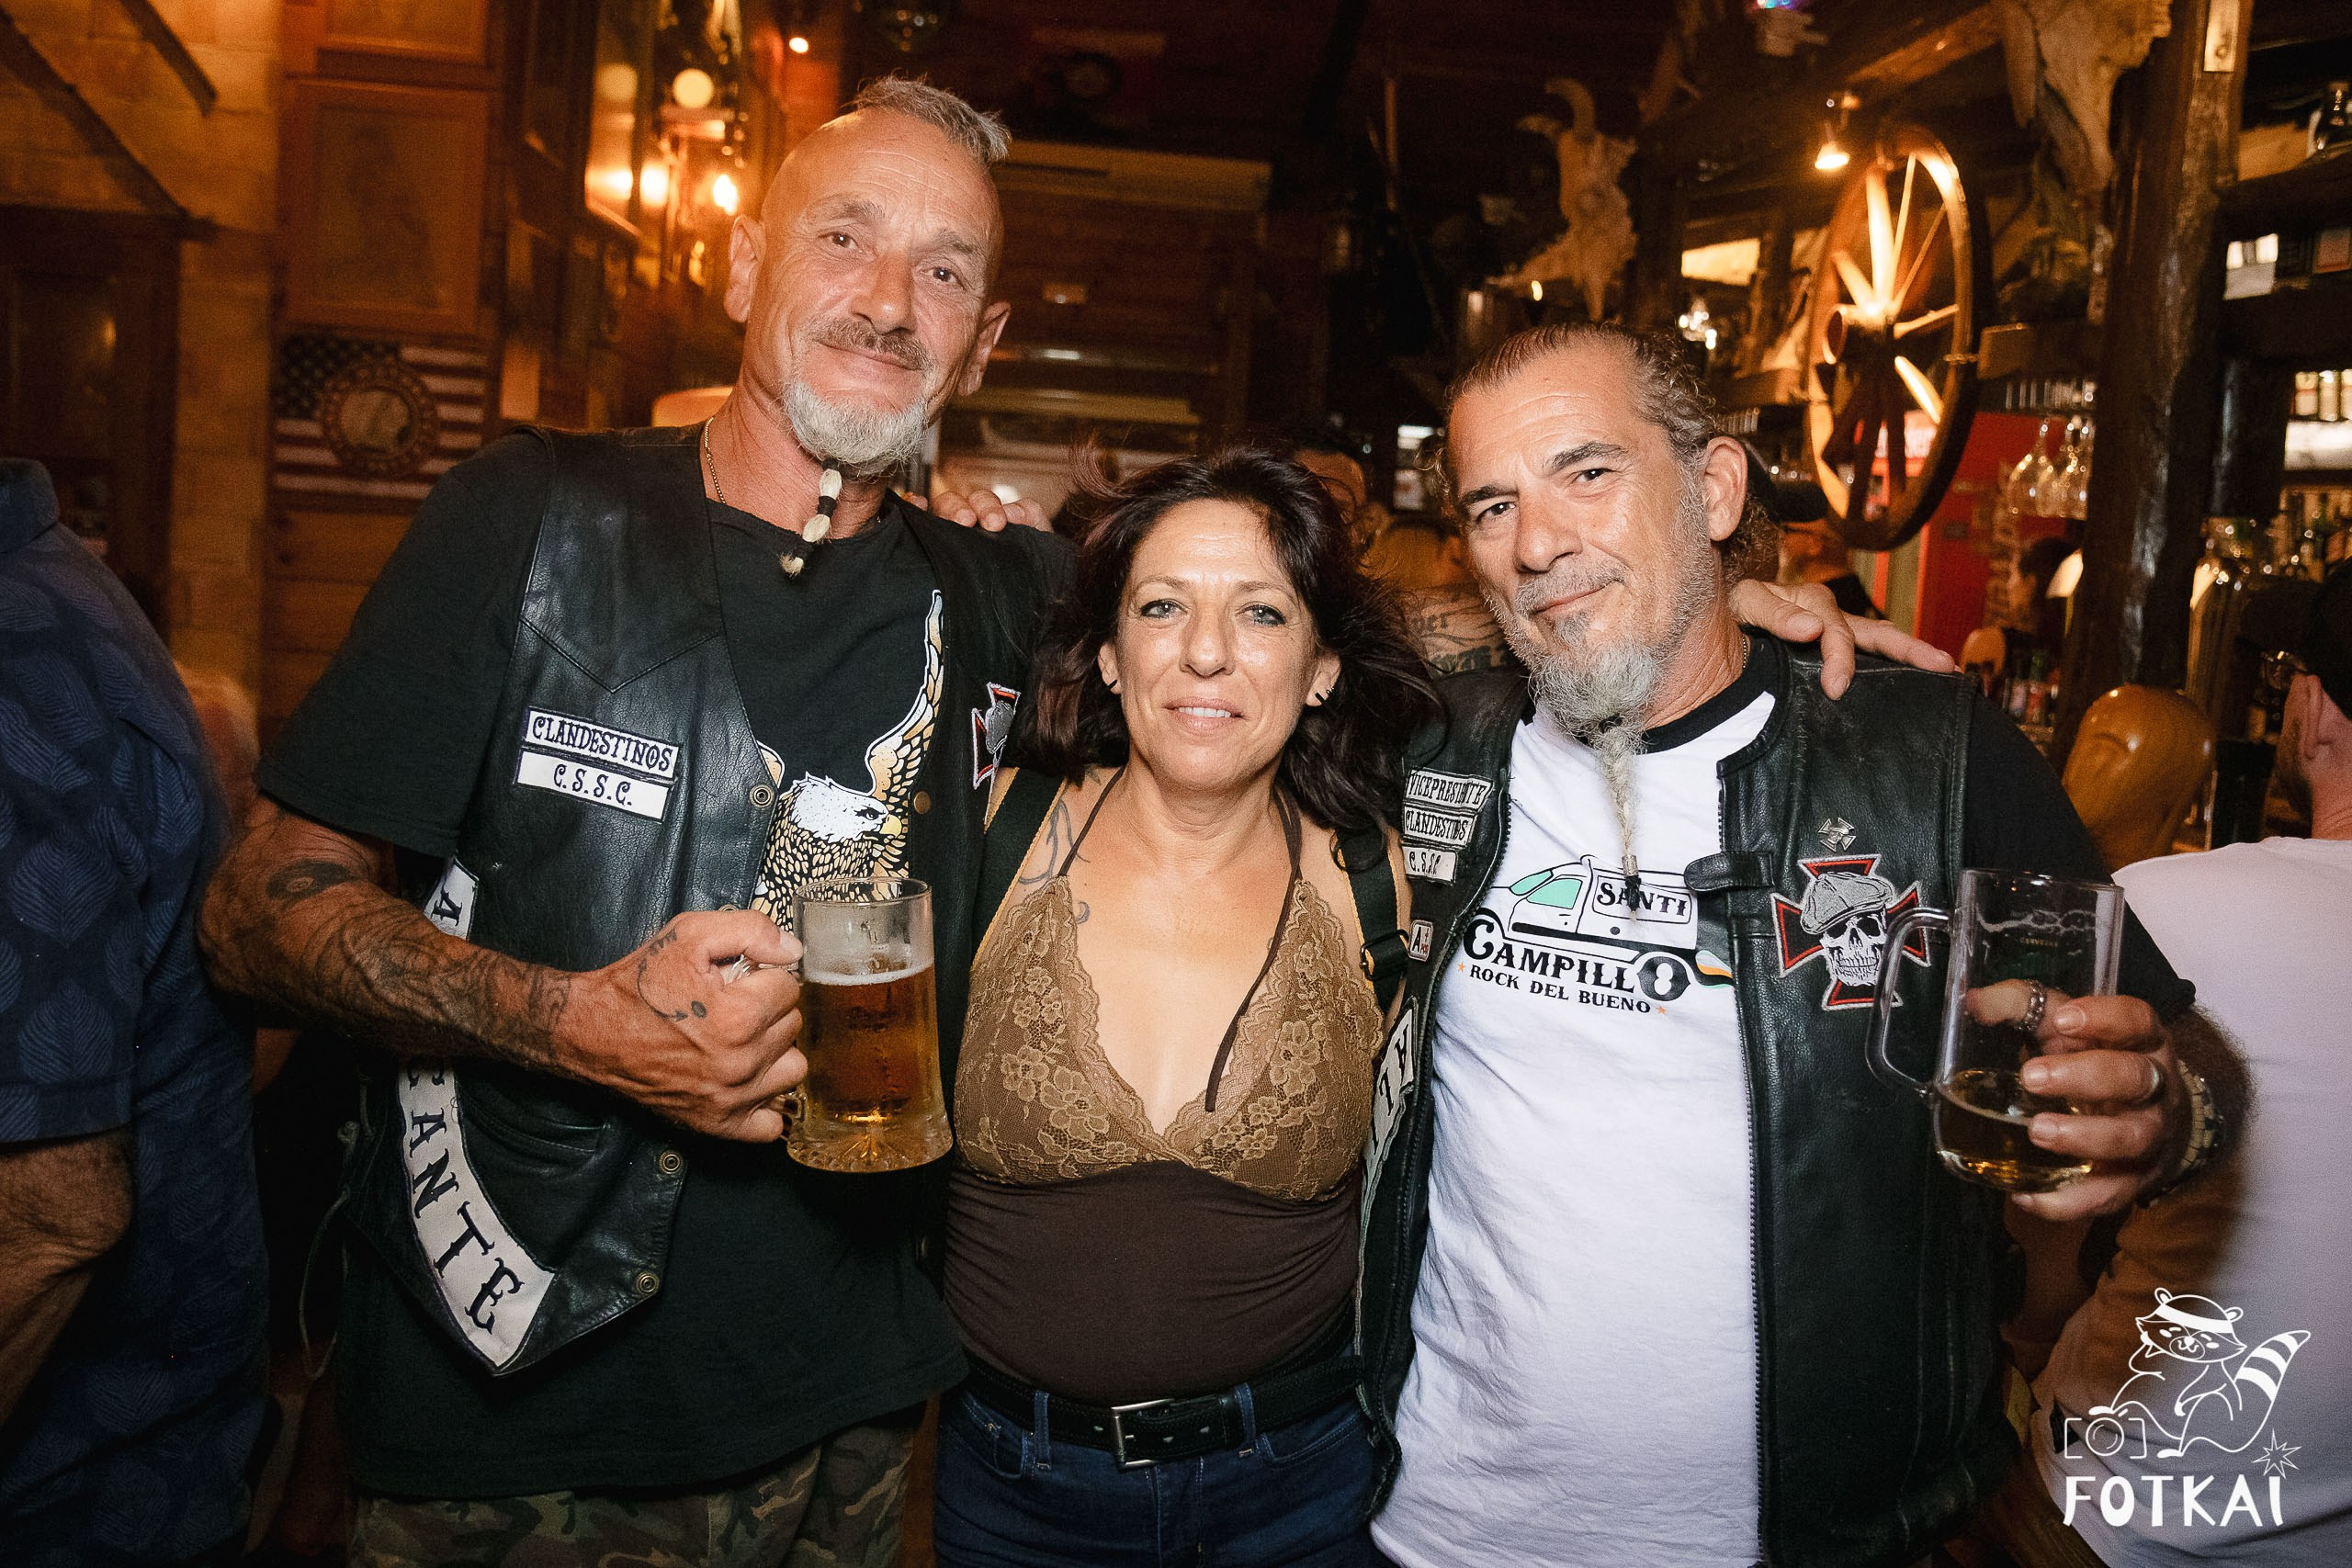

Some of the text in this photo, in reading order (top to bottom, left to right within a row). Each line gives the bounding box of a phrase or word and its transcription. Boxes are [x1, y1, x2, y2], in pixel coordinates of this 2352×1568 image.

[532, 715, 674, 772] CLANDESTINOS
[1596, 882, 1688, 917] SANTI
[1463, 917, 1691, 1002] CAMPILLO
[1469, 964, 1651, 1014] ROCK DEL BUENO
